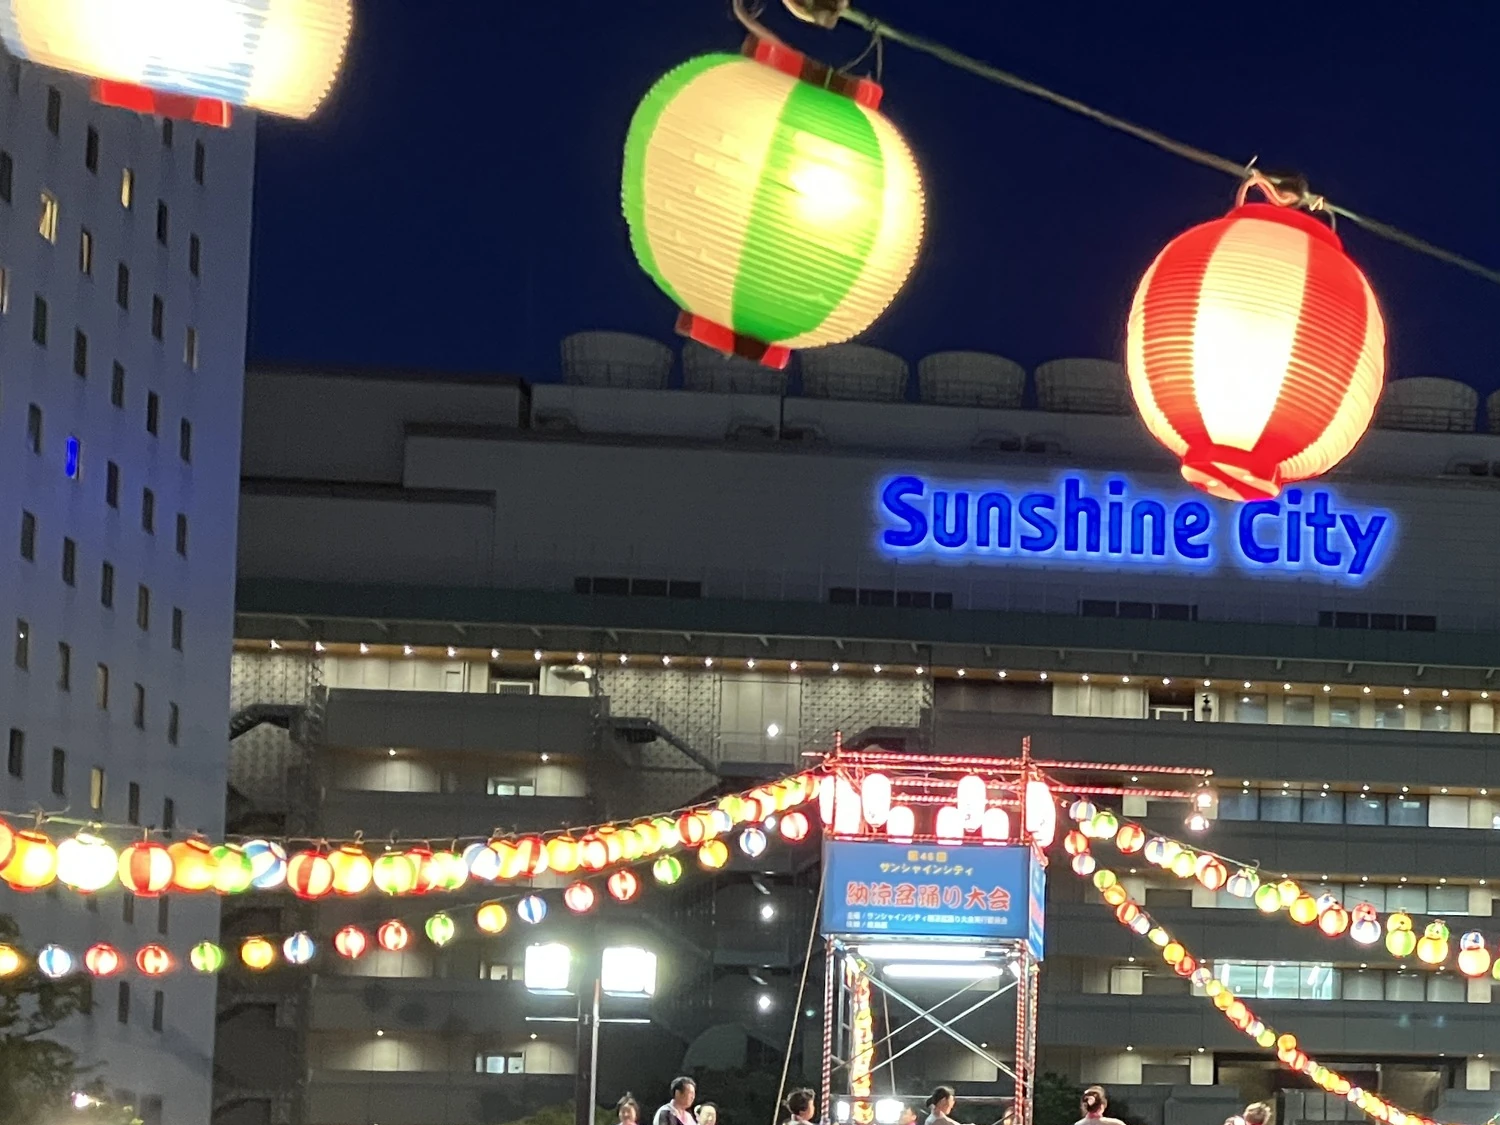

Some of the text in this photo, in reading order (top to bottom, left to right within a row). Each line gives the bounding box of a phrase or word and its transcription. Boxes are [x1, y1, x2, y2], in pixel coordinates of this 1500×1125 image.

[882, 476, 1387, 574] Sunshine City
[880, 863, 974, 877] サンシャインシティ
[846, 881, 1011, 911] 納涼盆踊り大会
